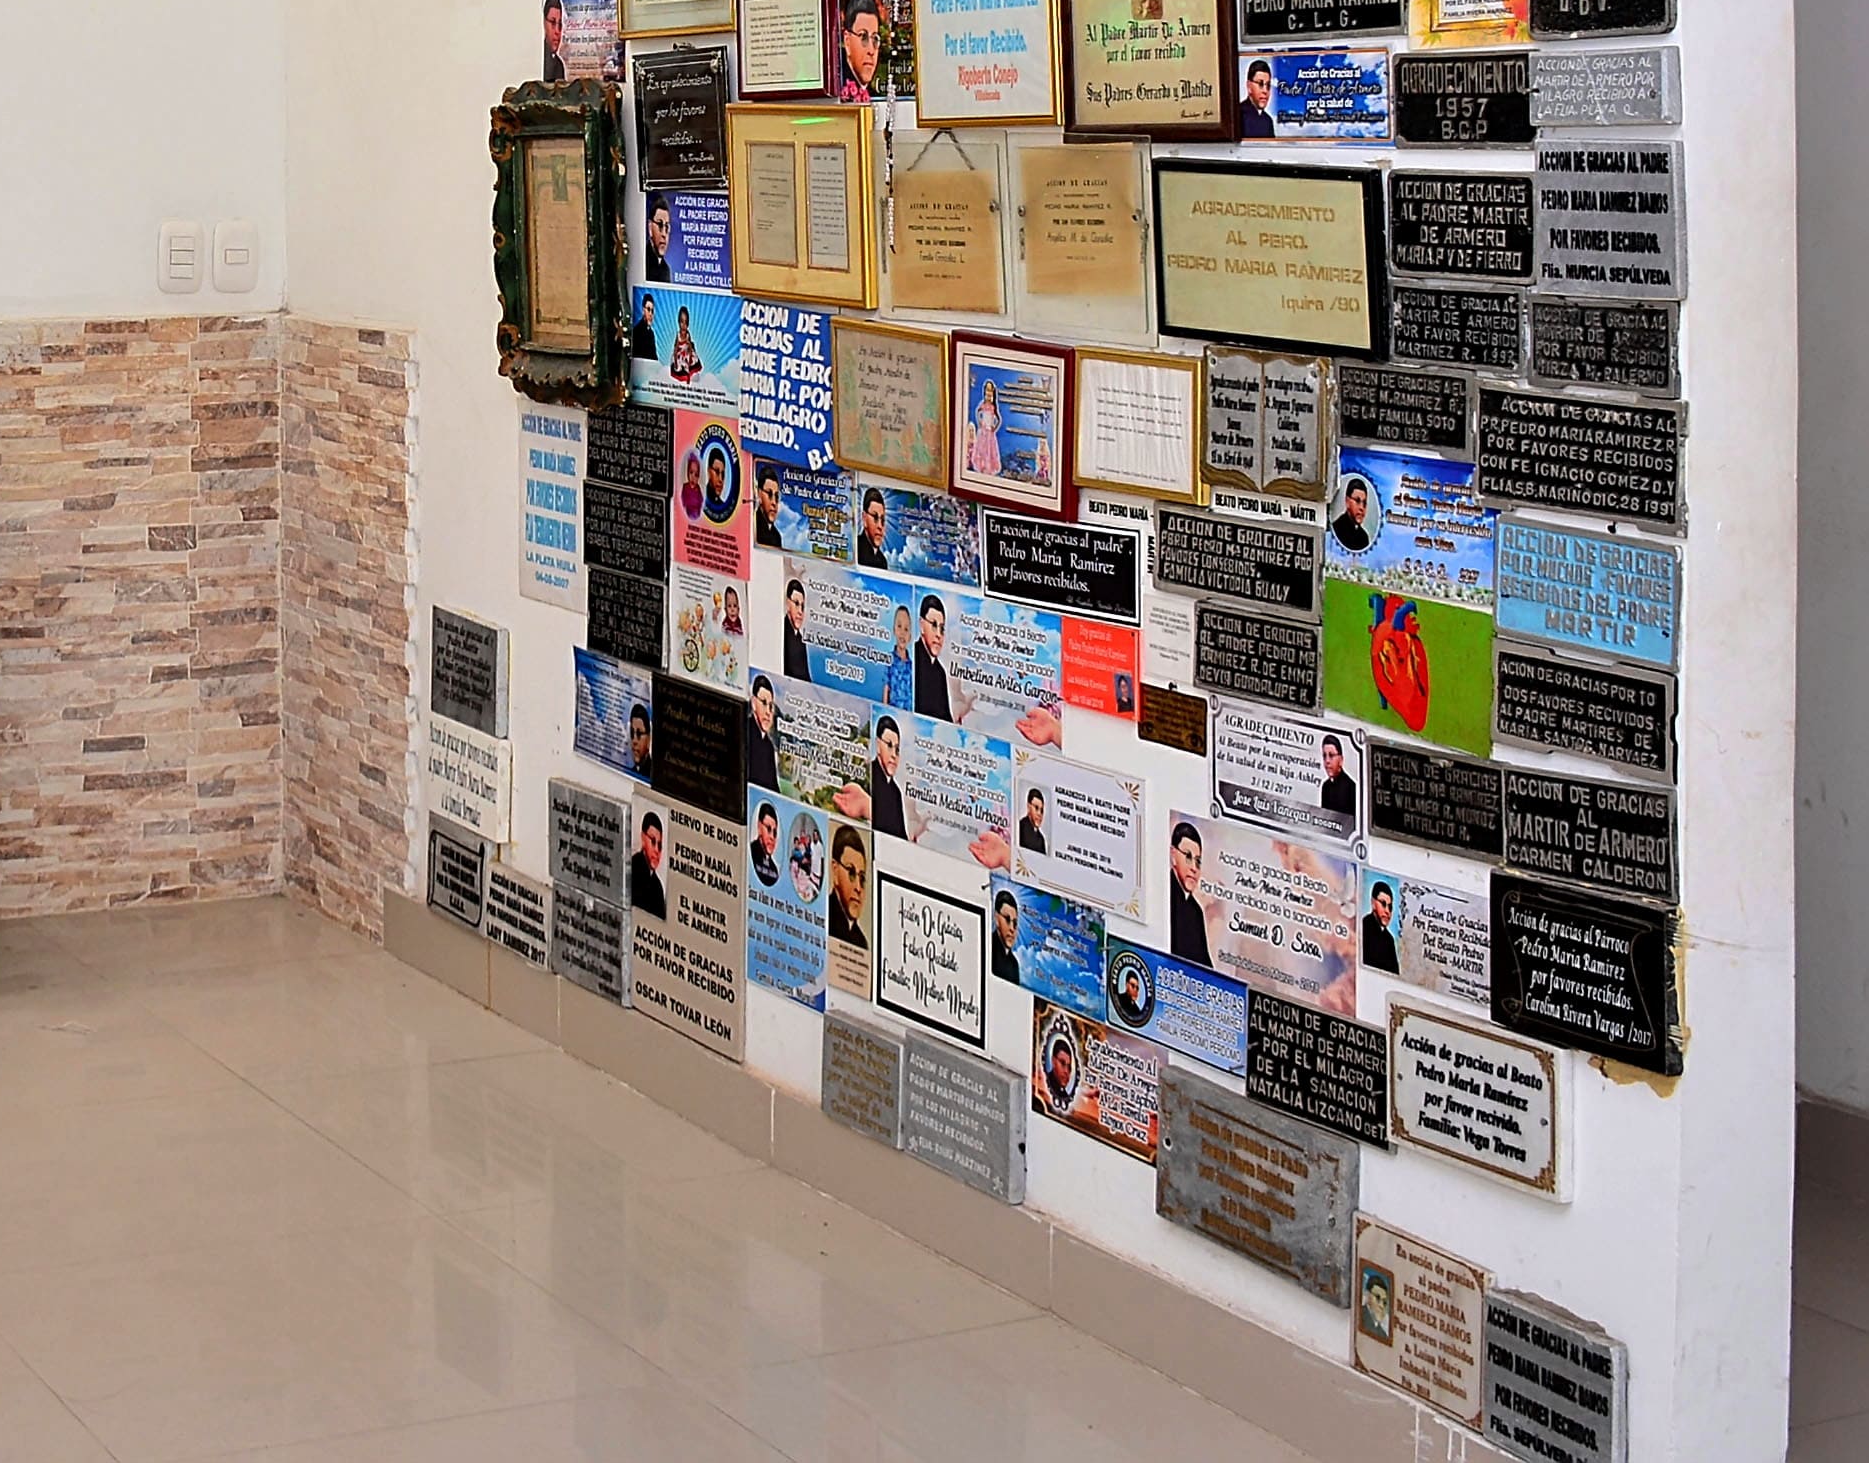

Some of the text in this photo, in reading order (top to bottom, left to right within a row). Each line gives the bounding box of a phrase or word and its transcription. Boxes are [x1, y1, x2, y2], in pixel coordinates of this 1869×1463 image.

[1288, 9, 1357, 30] C. L. G.
[1191, 200, 1335, 222] AGRADECIMIENTO
[1226, 230, 1247, 246] AL
[1167, 254, 1364, 284] PEDRO MARIA RAMIREZ
[740, 301, 821, 335] ACCION DE
[1281, 294, 1324, 314] Iquira
[740, 324, 824, 361] GRACIAS AL
[740, 348, 777, 374] PADRE
[755, 397, 826, 434] MILAGRO
[990, 520, 1001, 534] En
[1003, 524, 1030, 538] acción
[1032, 525, 1043, 541] de
[1045, 531, 1078, 547] gracias
[1080, 532, 1088, 548] al
[999, 541, 1026, 560] Pedro
[993, 564, 1090, 592] por favores recibidos.
[1507, 775, 1666, 819] ACCION DE GRACIAS
[670, 809, 738, 847] SIERVO DE DIOS
[1577, 808, 1598, 829] AL
[675, 842, 702, 864] PEDRO
[1508, 812, 1666, 865] MARTIR DE ARMERO
[1509, 845, 1666, 891] CARMEN CALDERON
[708, 873, 738, 897] RAMOS
[680, 895, 726, 927] EL MARTIR
[678, 911, 728, 943] DE ARMERO
[633, 942, 735, 1003] POR FAVOR RECIBIDO
[673, 943, 686, 961] DE
[689, 951, 733, 983] GRACIAS
[635, 981, 667, 1008] OSCAR
[670, 998, 702, 1026] TOVAR
[1401, 1032, 1436, 1056] Acción
[1439, 1044, 1452, 1061] de
[1497, 1064, 1508, 1079] al
[1511, 1067, 1542, 1090] Beato
[1416, 1061, 1445, 1083] Pedro
[1424, 1092, 1443, 1107] por
[1464, 1125, 1490, 1151] Vega
[1493, 1136, 1526, 1162] Torres
